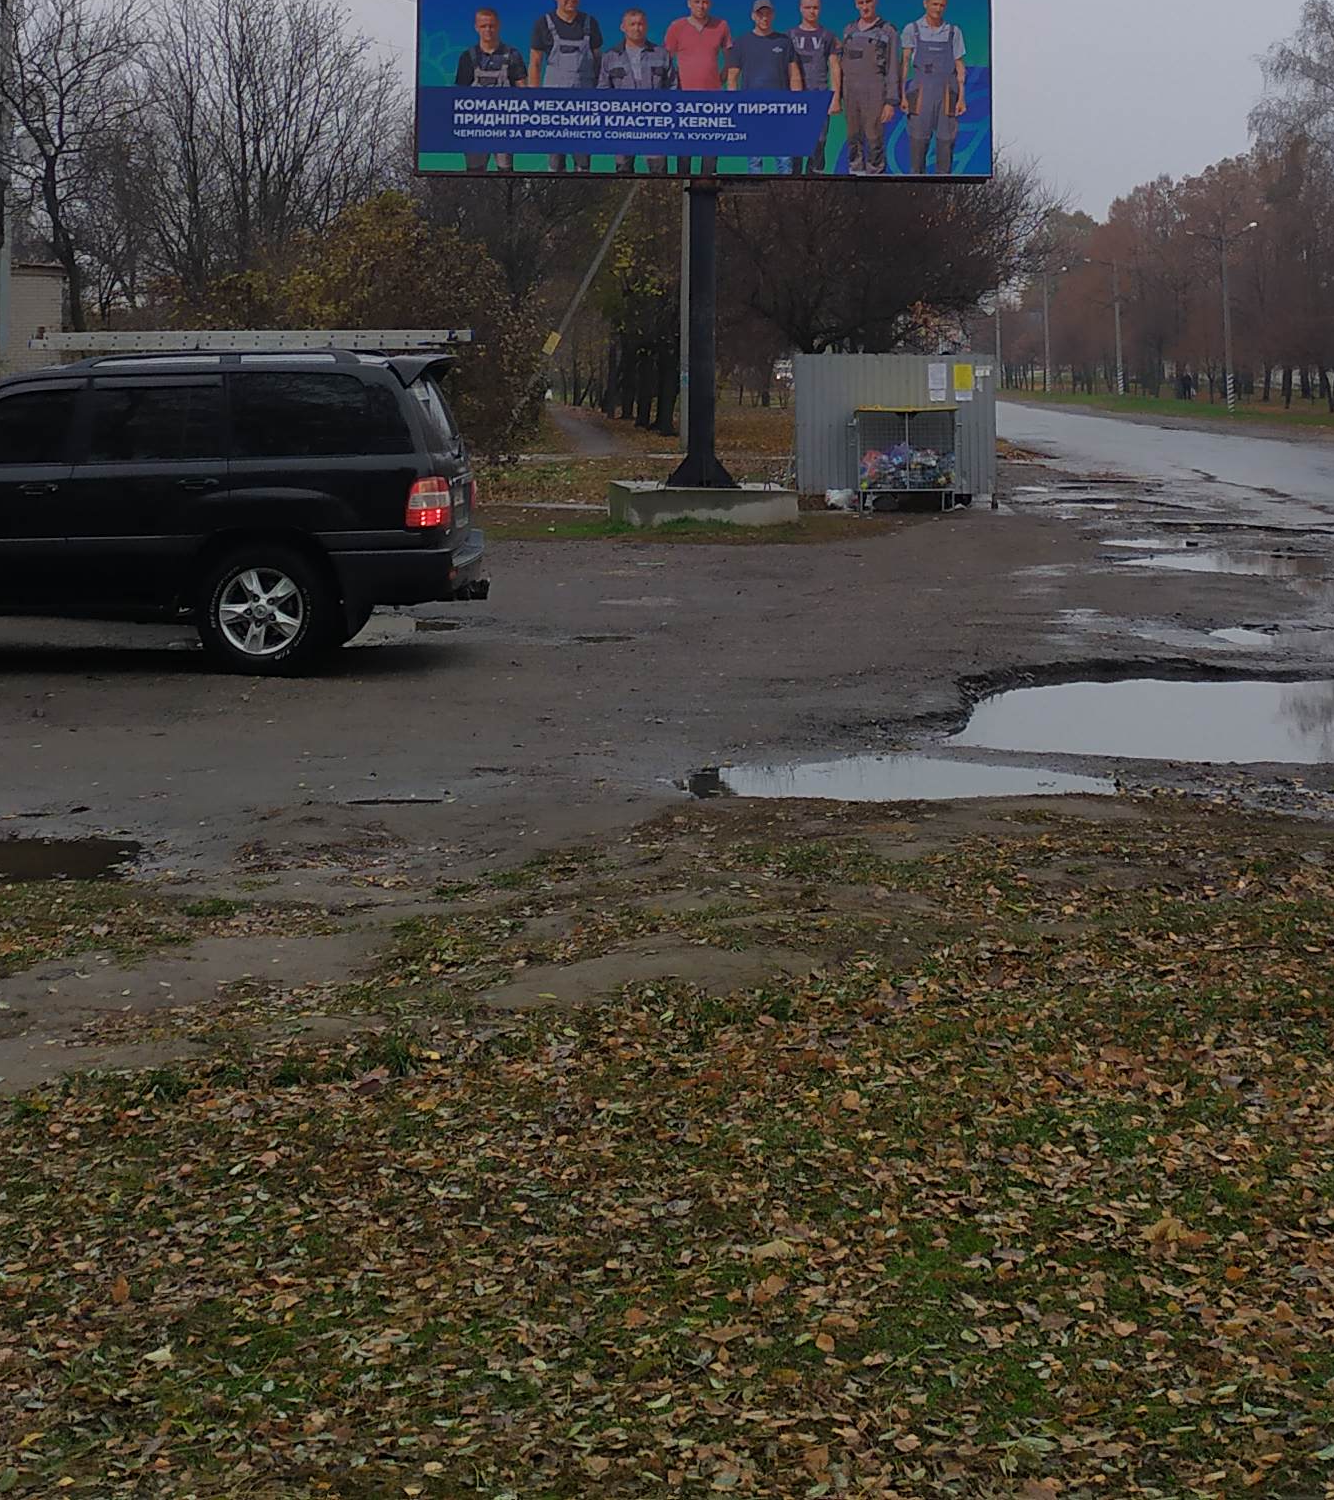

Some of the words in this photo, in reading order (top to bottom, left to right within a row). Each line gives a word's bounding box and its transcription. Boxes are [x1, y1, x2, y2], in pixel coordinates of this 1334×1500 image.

[453, 99, 530, 113] КОМАНДА
[533, 100, 672, 114] МЕХАНІЗОВАНОГО
[675, 101, 735, 115] ЗАГОНУ
[738, 102, 808, 116] ПИРЯТИН
[453, 112, 602, 127] ПРИДНІПРОВСЬКИЙ
[604, 115, 676, 129] КЛАСТЕР,
[678, 116, 736, 128] KERNEL
[453, 129, 507, 138] ЧЕМПІОНИ
[509, 130, 523, 138] ЗА
[524, 129, 602, 140] ВРОЖАЙНІСТЮ
[604, 131, 670, 141] СОНЯШНИКУ
[672, 132, 685, 140] ТА
[687, 132, 747, 142] КУКУРУДЗИ
